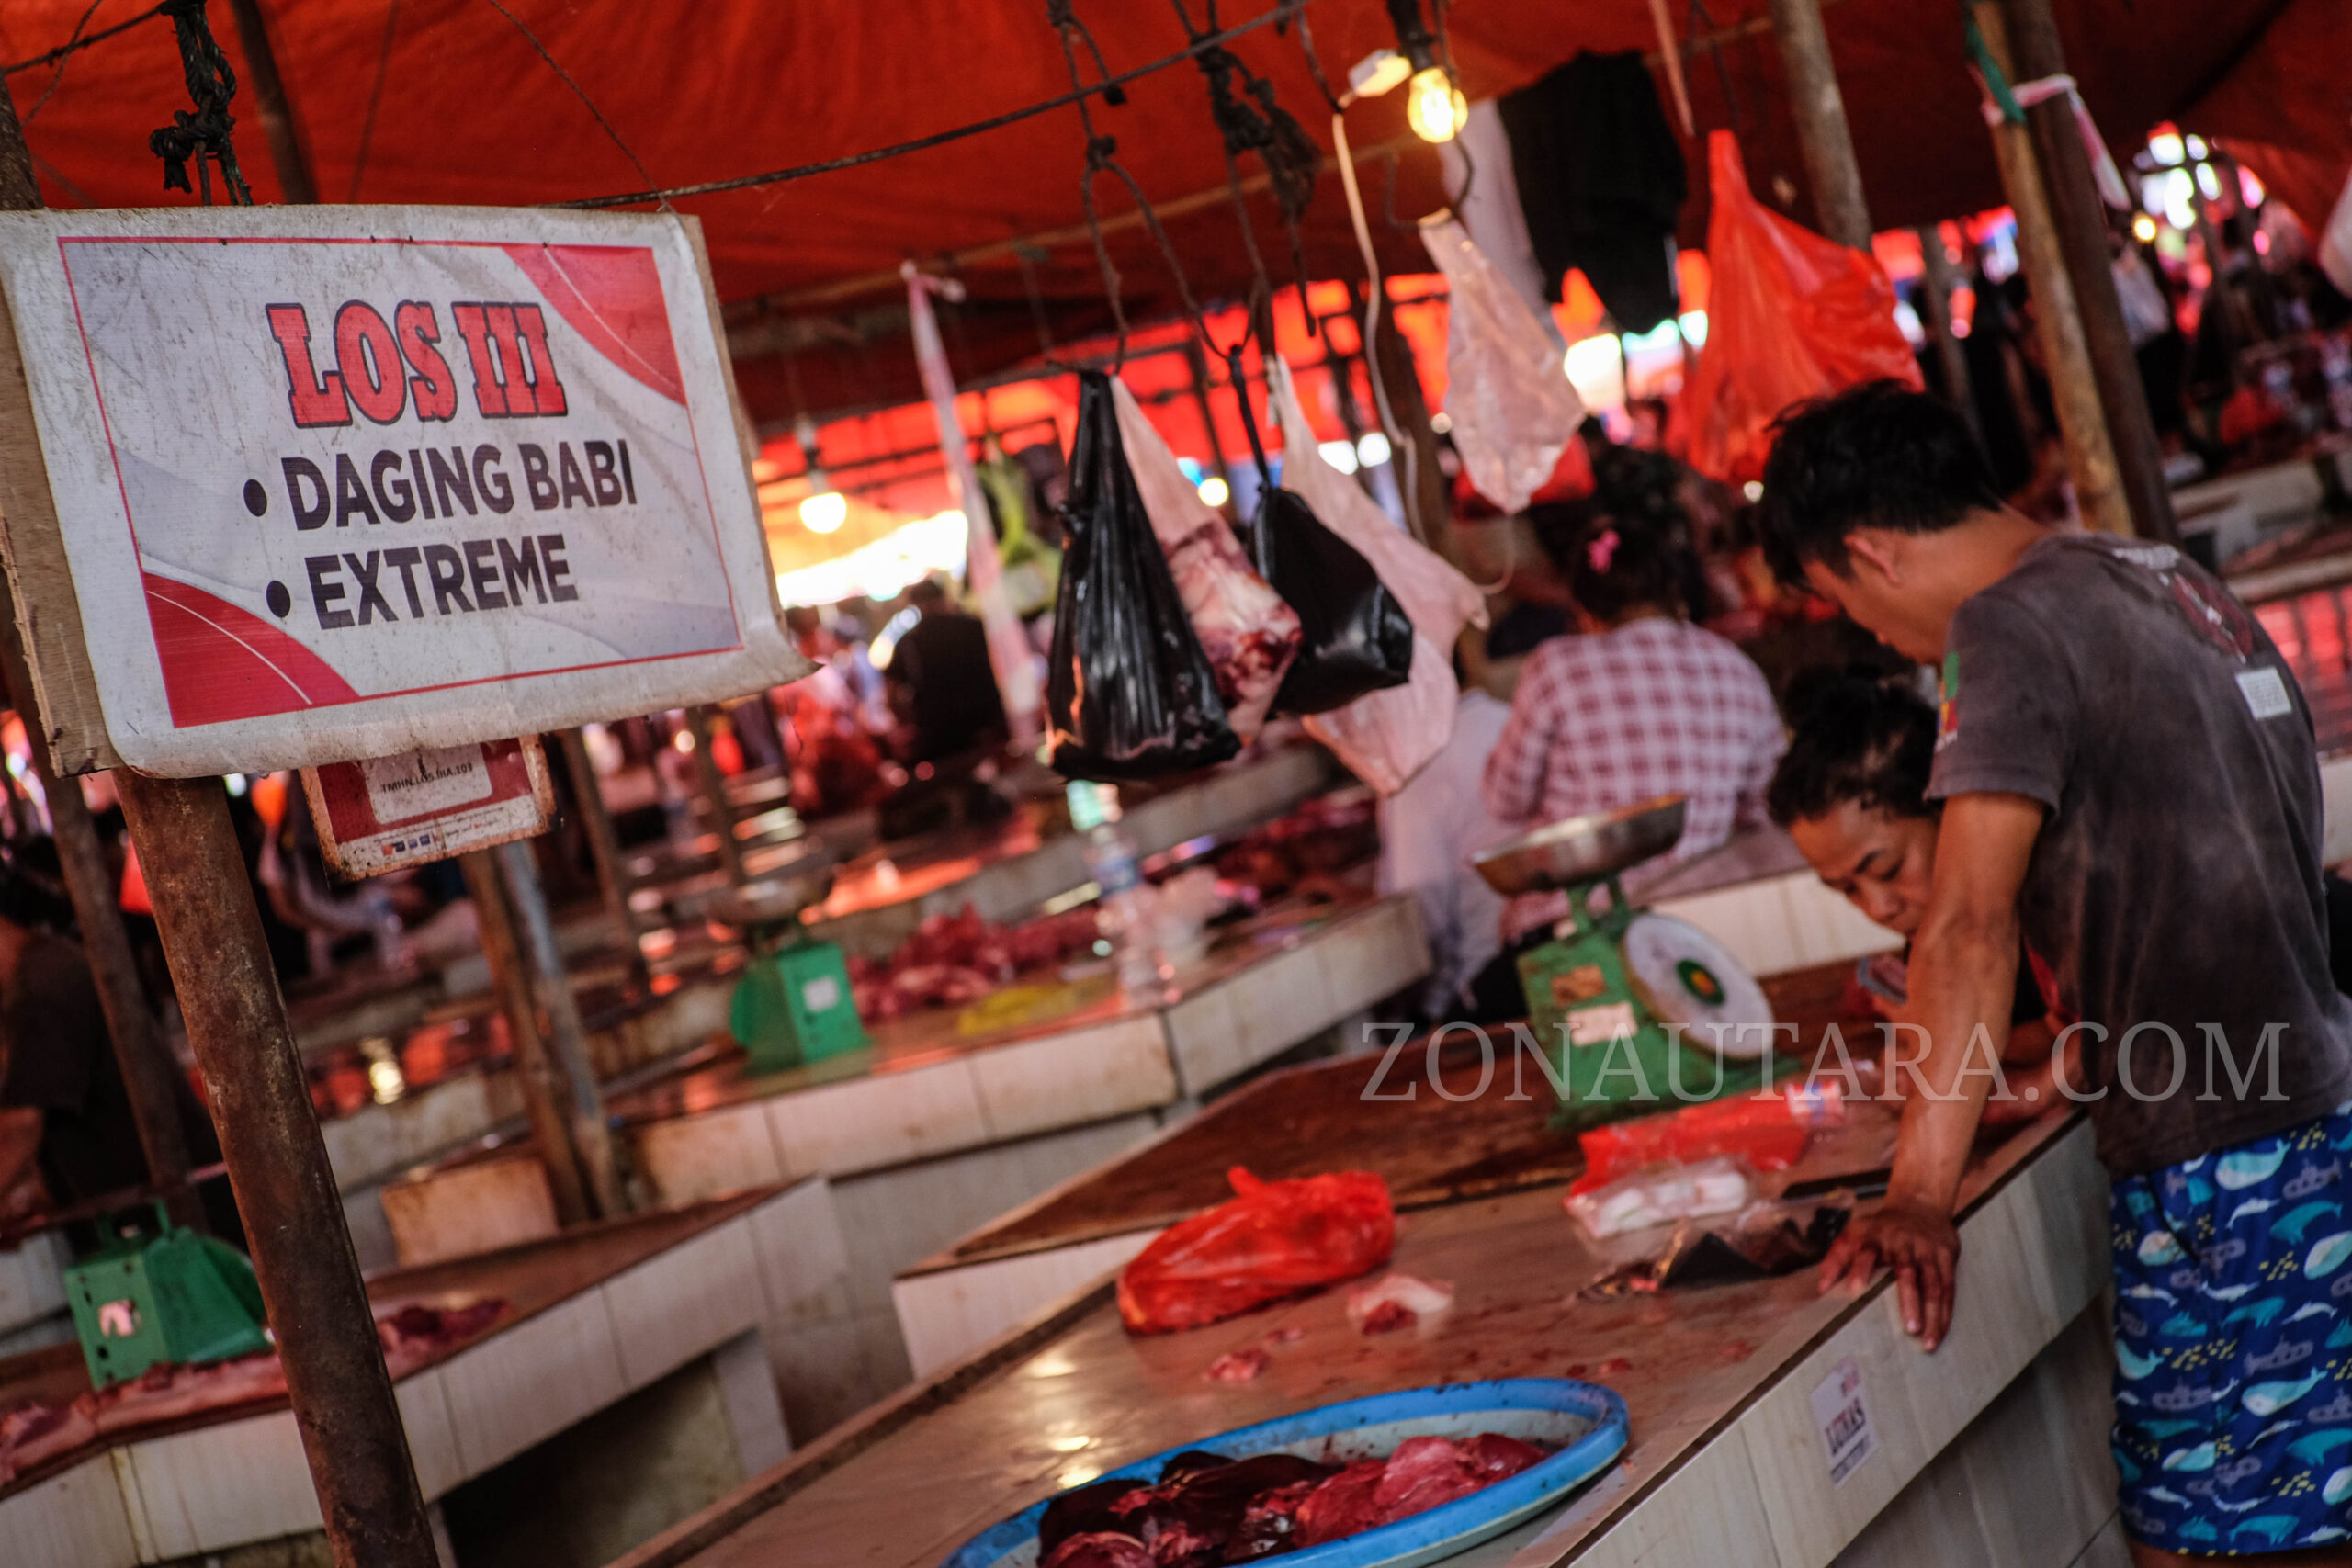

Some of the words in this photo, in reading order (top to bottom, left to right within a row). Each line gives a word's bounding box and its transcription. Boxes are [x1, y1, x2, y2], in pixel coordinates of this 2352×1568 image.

[266, 300, 458, 428] LOS
[451, 302, 568, 418] III
[281, 444, 515, 531] DAGING
[518, 439, 638, 512] BABI
[303, 534, 579, 631] EXTREME
